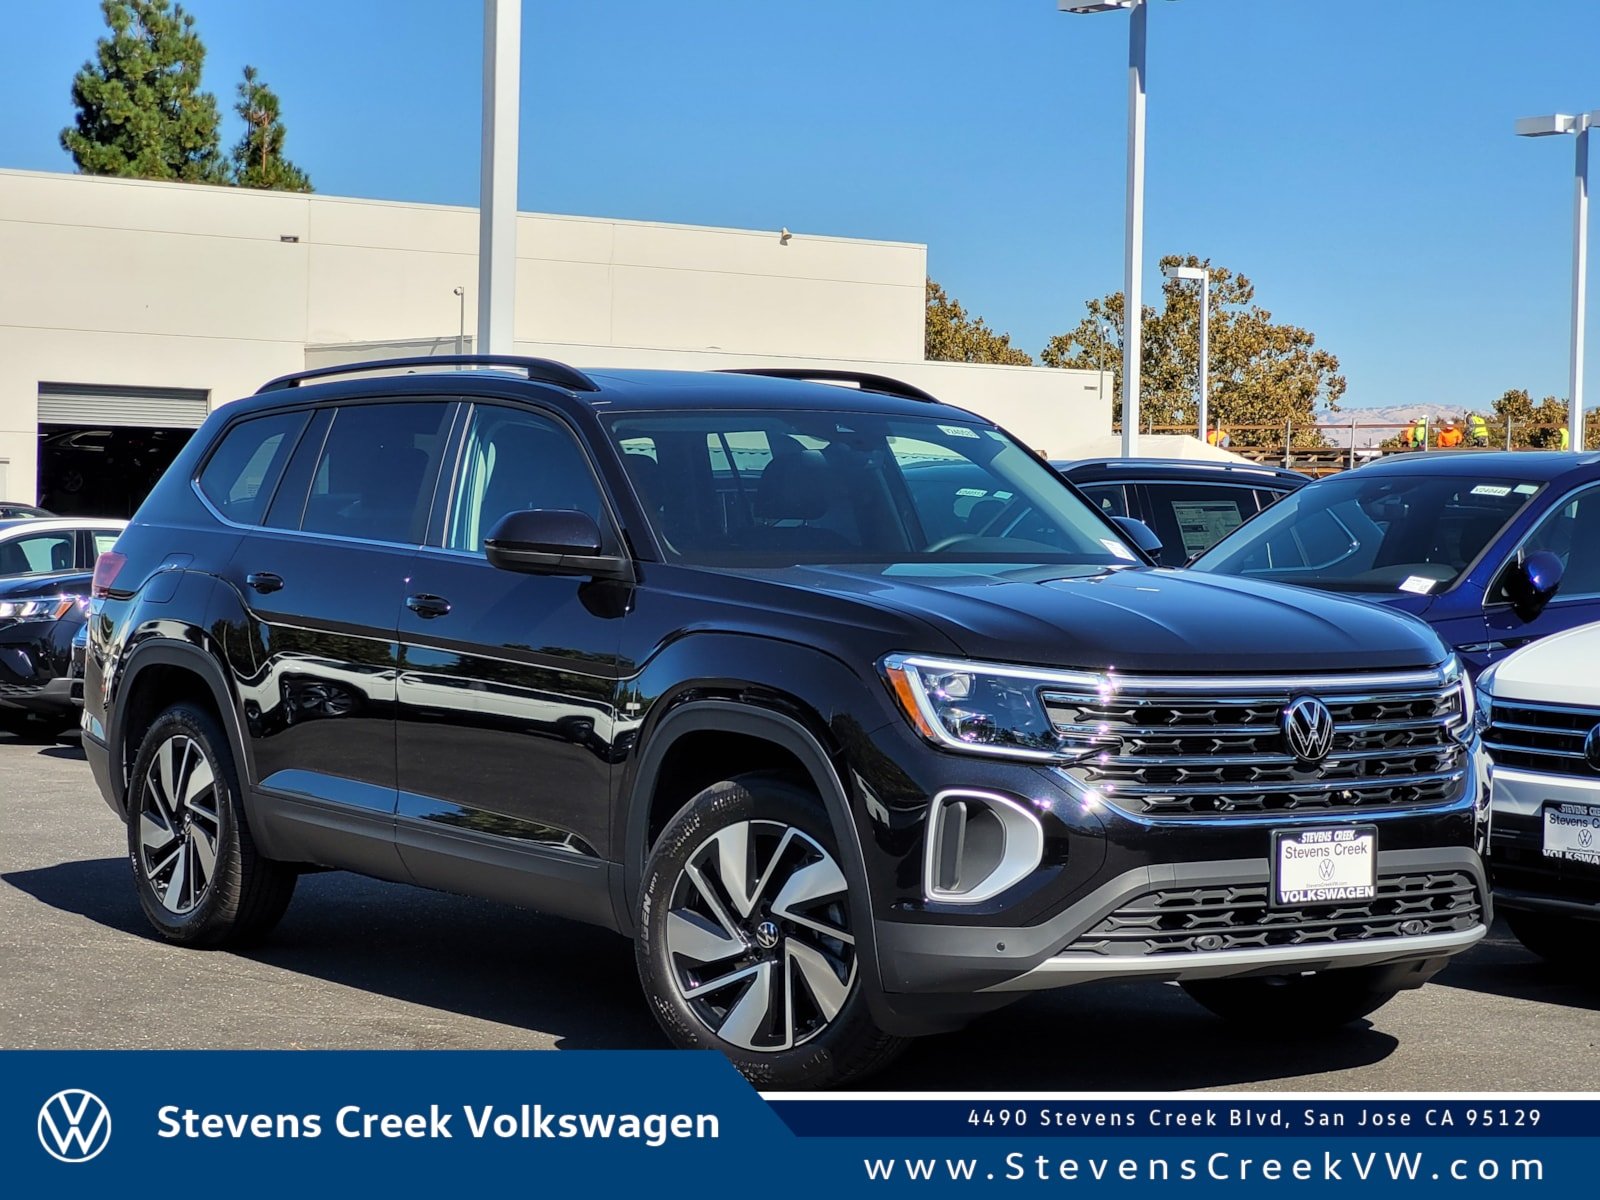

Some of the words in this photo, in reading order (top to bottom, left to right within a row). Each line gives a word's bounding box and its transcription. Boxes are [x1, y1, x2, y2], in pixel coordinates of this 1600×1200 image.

[1549, 814, 1587, 827] Stevens
[1302, 831, 1332, 843] STEVENS
[1334, 830, 1355, 841] CREEK
[1285, 846, 1330, 859] Stevens
[1334, 842, 1367, 856] Creek
[1281, 886, 1375, 903] VOLKSWAGEN
